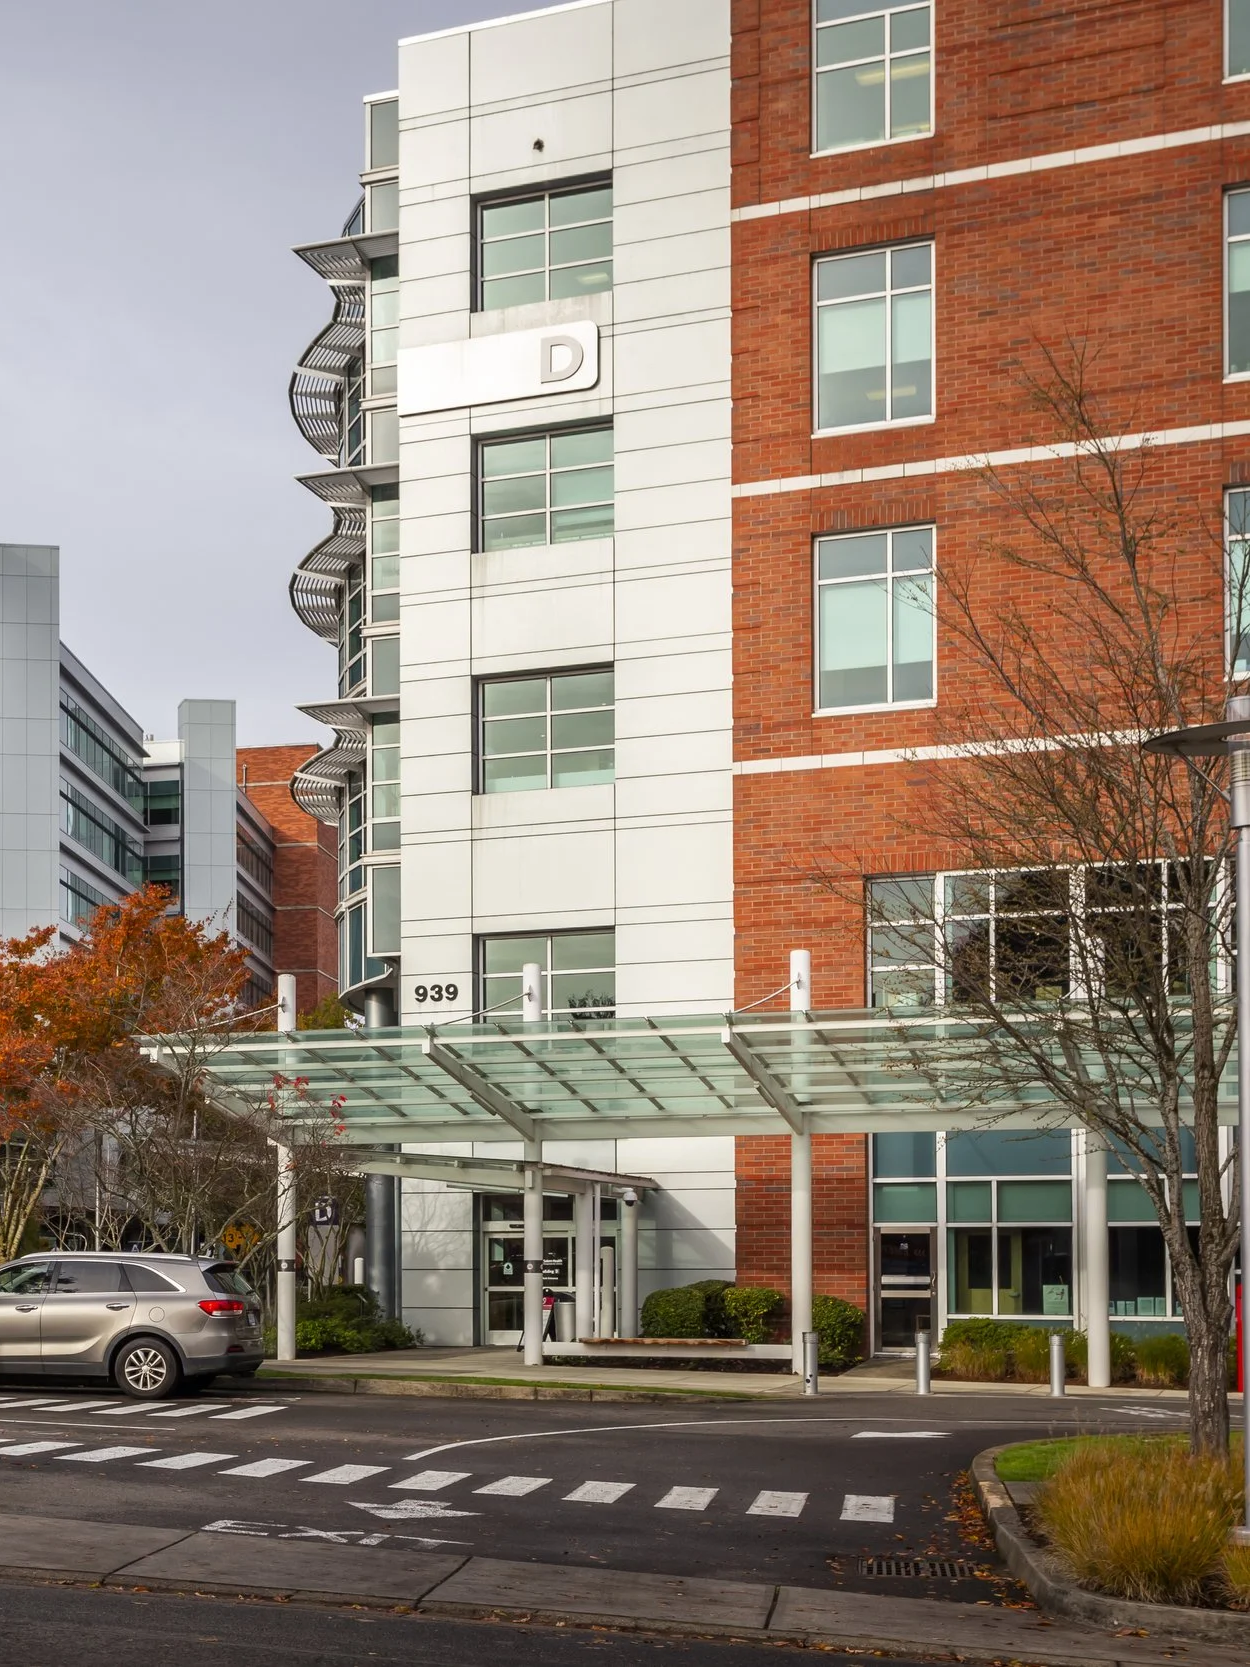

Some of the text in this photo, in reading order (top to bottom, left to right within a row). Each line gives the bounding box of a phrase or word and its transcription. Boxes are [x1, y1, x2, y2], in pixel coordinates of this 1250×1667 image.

[541, 335, 584, 384] D
[414, 983, 459, 1003] 939
[200, 1519, 475, 1550] EXIT
